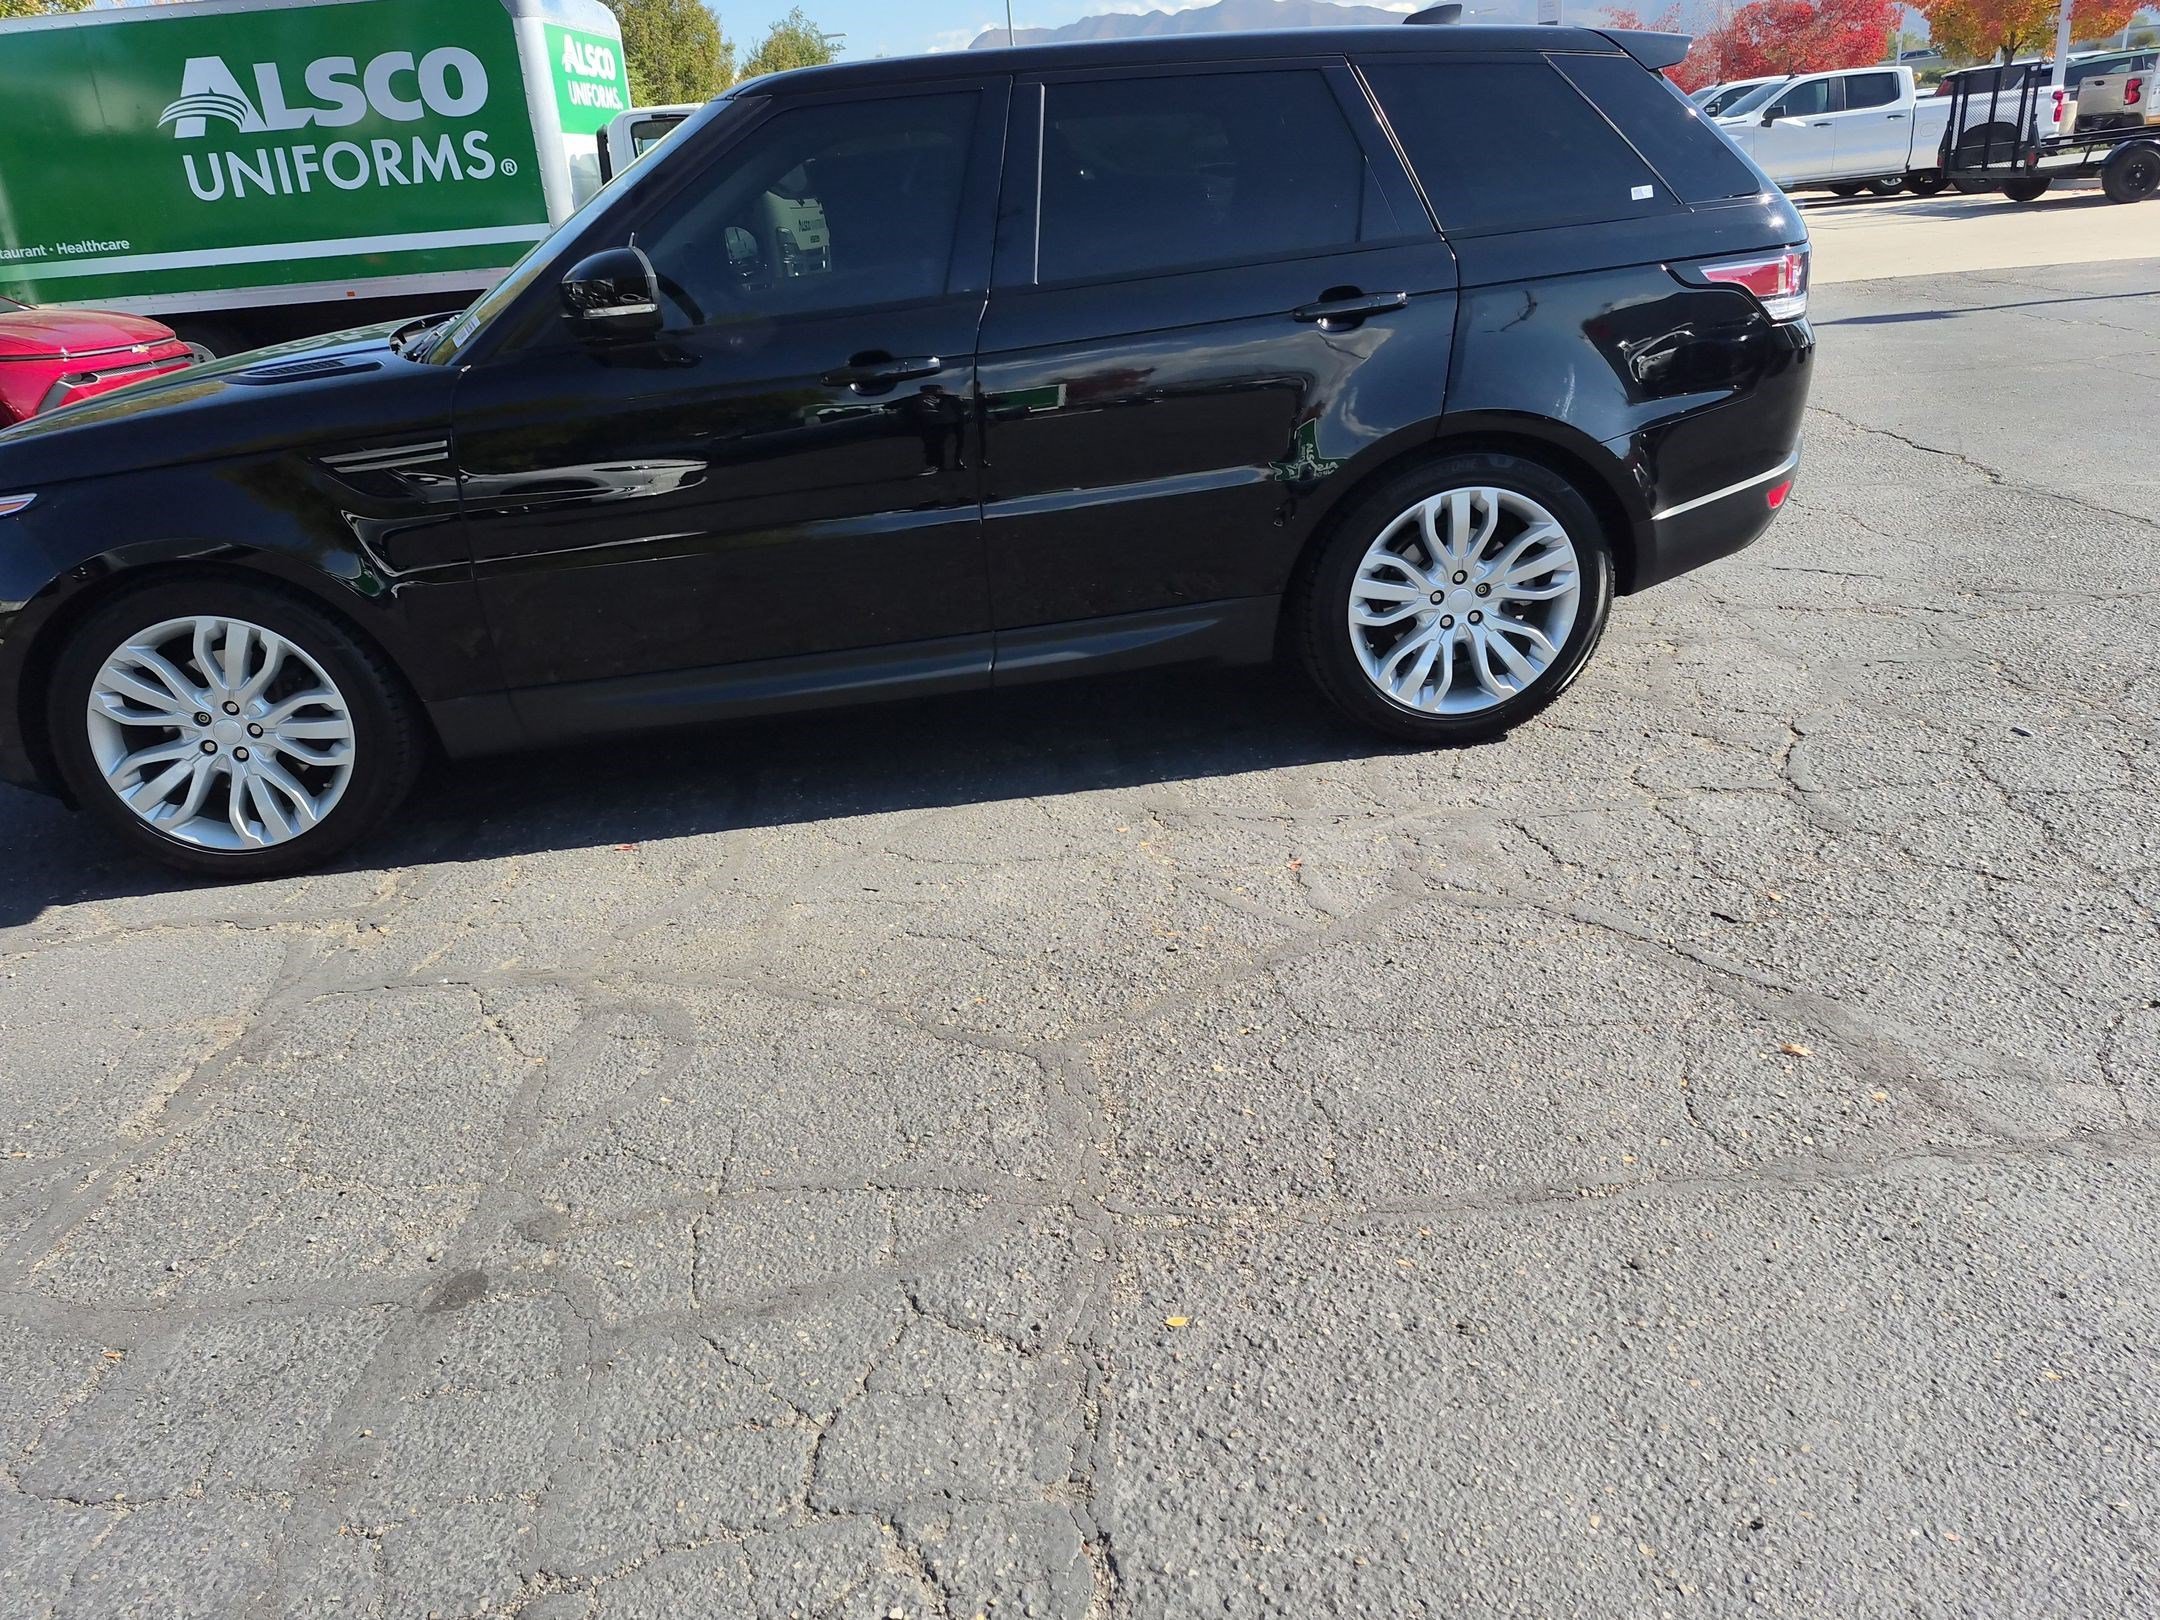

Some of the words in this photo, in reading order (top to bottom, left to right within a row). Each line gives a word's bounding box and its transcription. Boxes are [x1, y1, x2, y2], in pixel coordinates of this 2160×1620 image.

[561, 33, 617, 80] ALSCO
[156, 46, 489, 139] ALSCO
[56, 239, 130, 255] Healthcare
